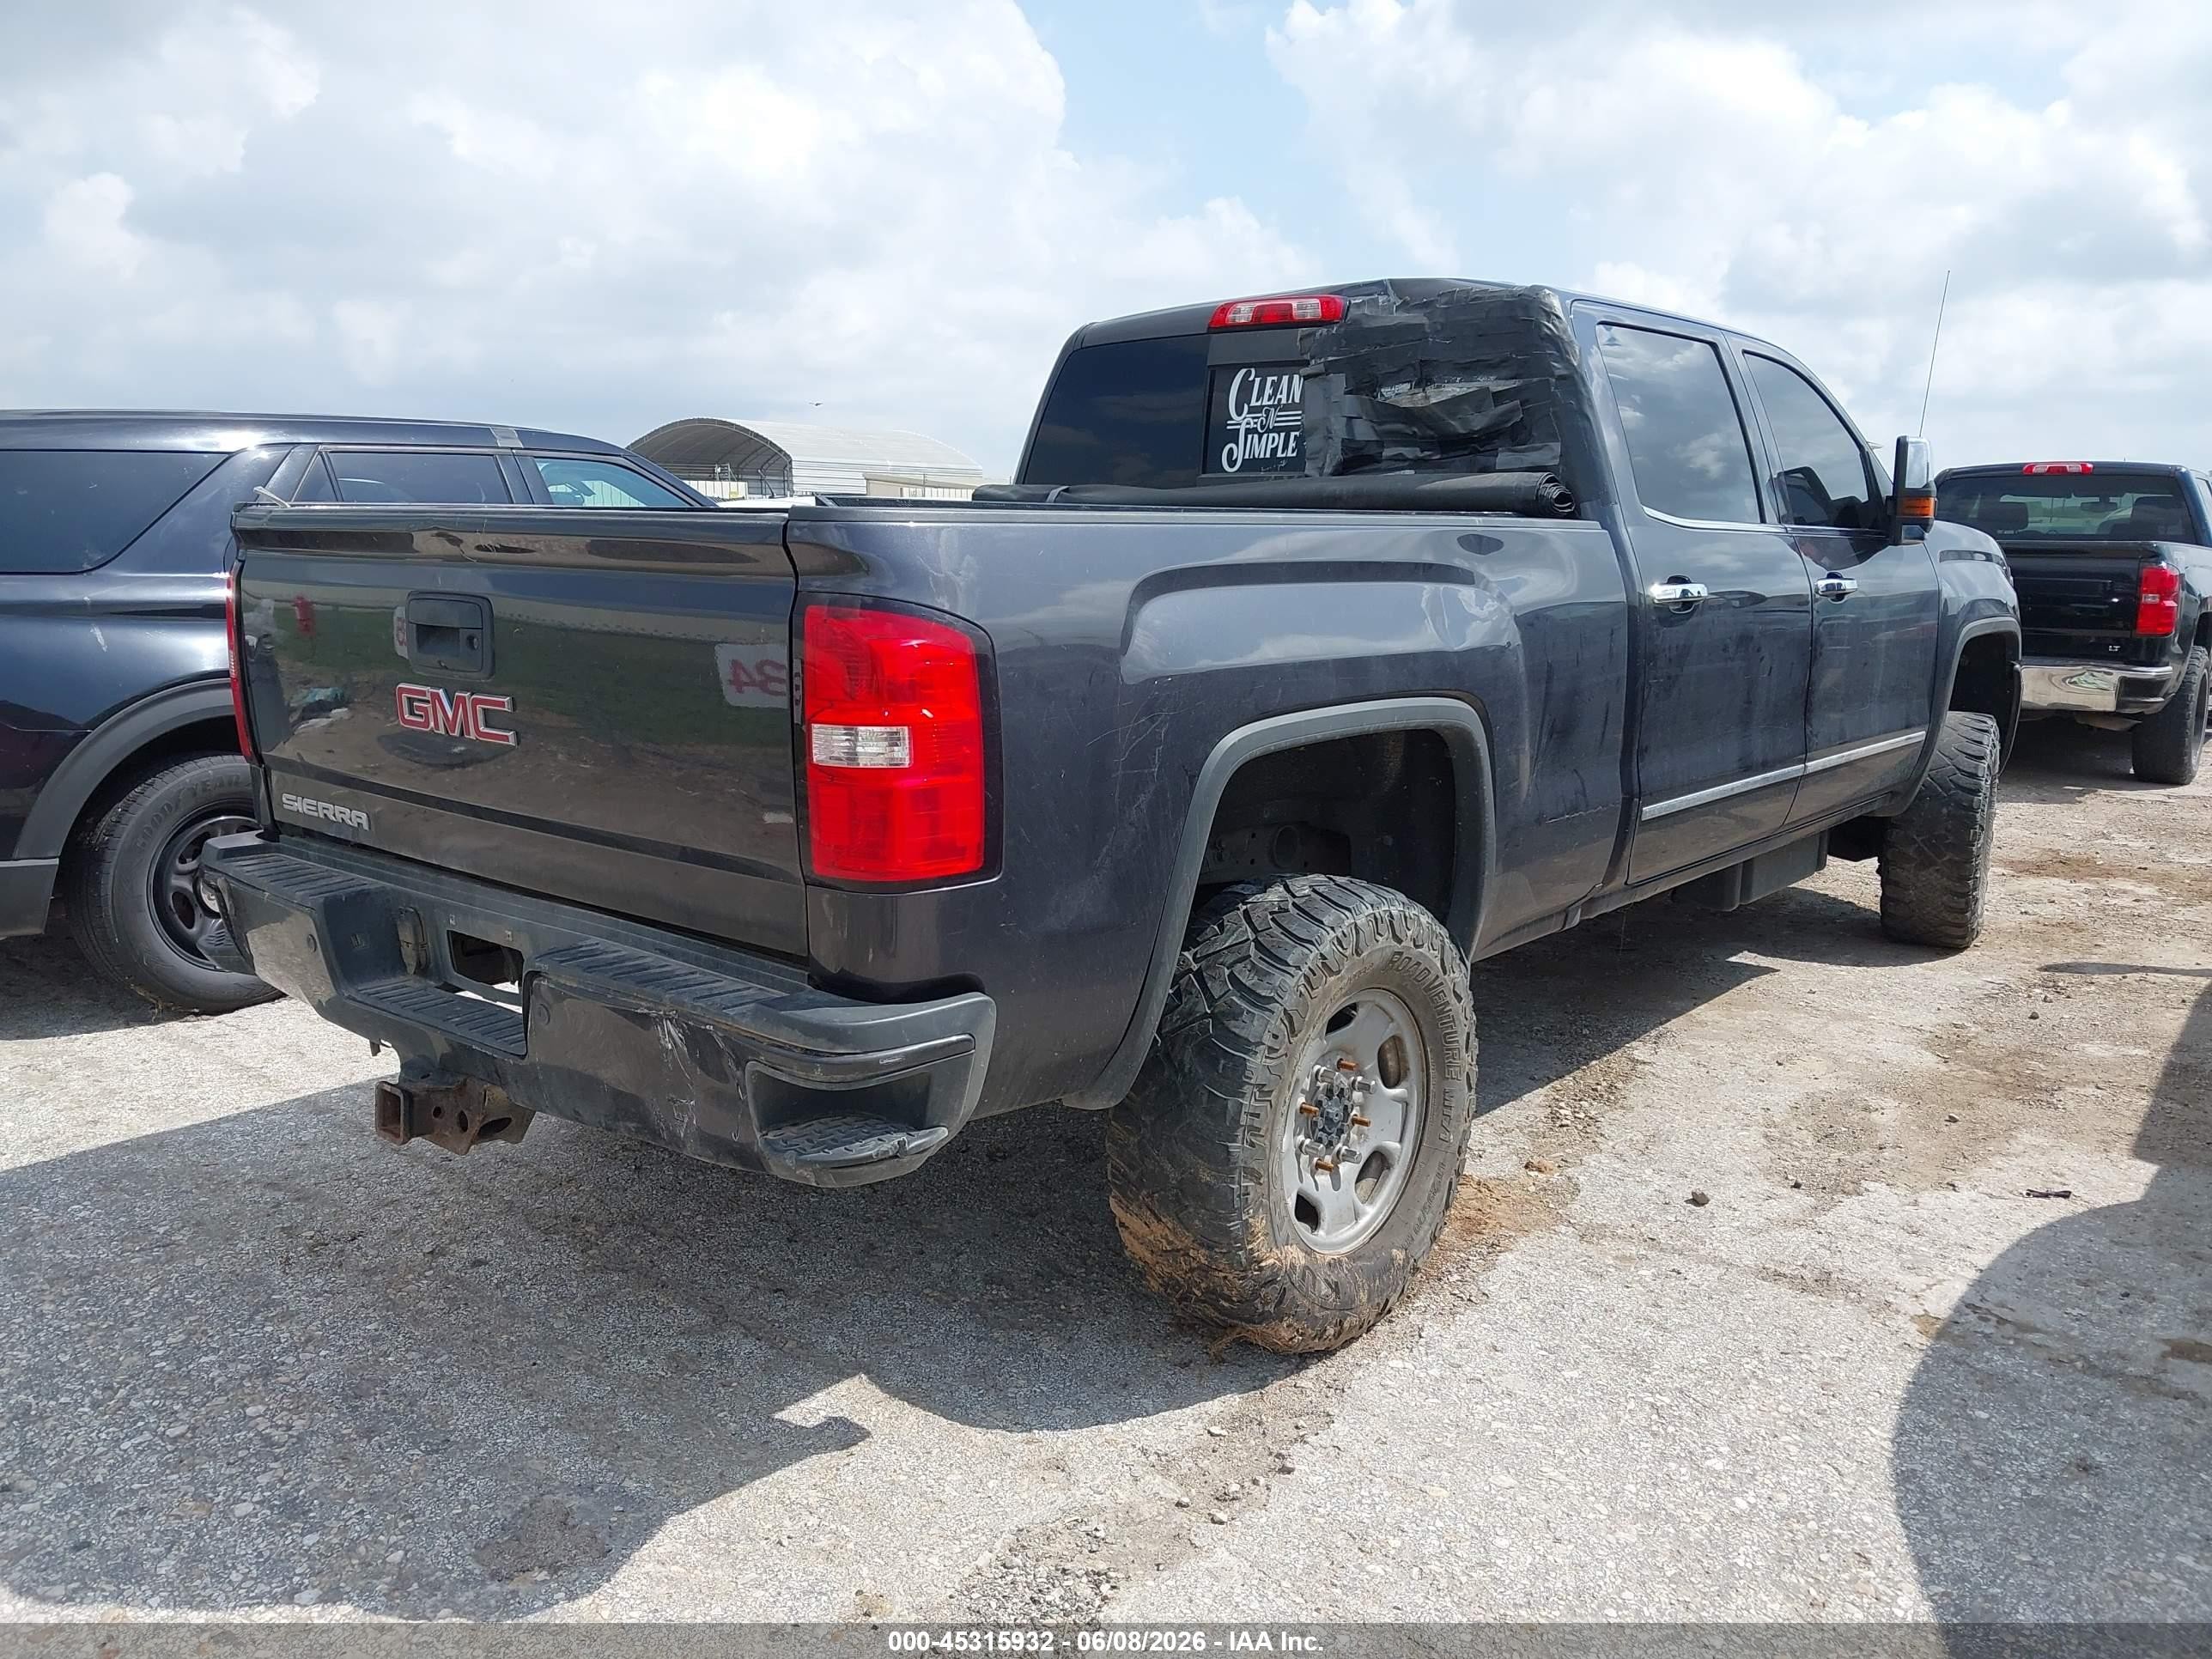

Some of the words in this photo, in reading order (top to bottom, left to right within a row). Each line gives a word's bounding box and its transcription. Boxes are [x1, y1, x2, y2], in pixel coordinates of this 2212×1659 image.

[1221, 417, 1300, 472] SIMPLE
[396, 683, 519, 748] GMC
[282, 793, 371, 831] SIERRA
